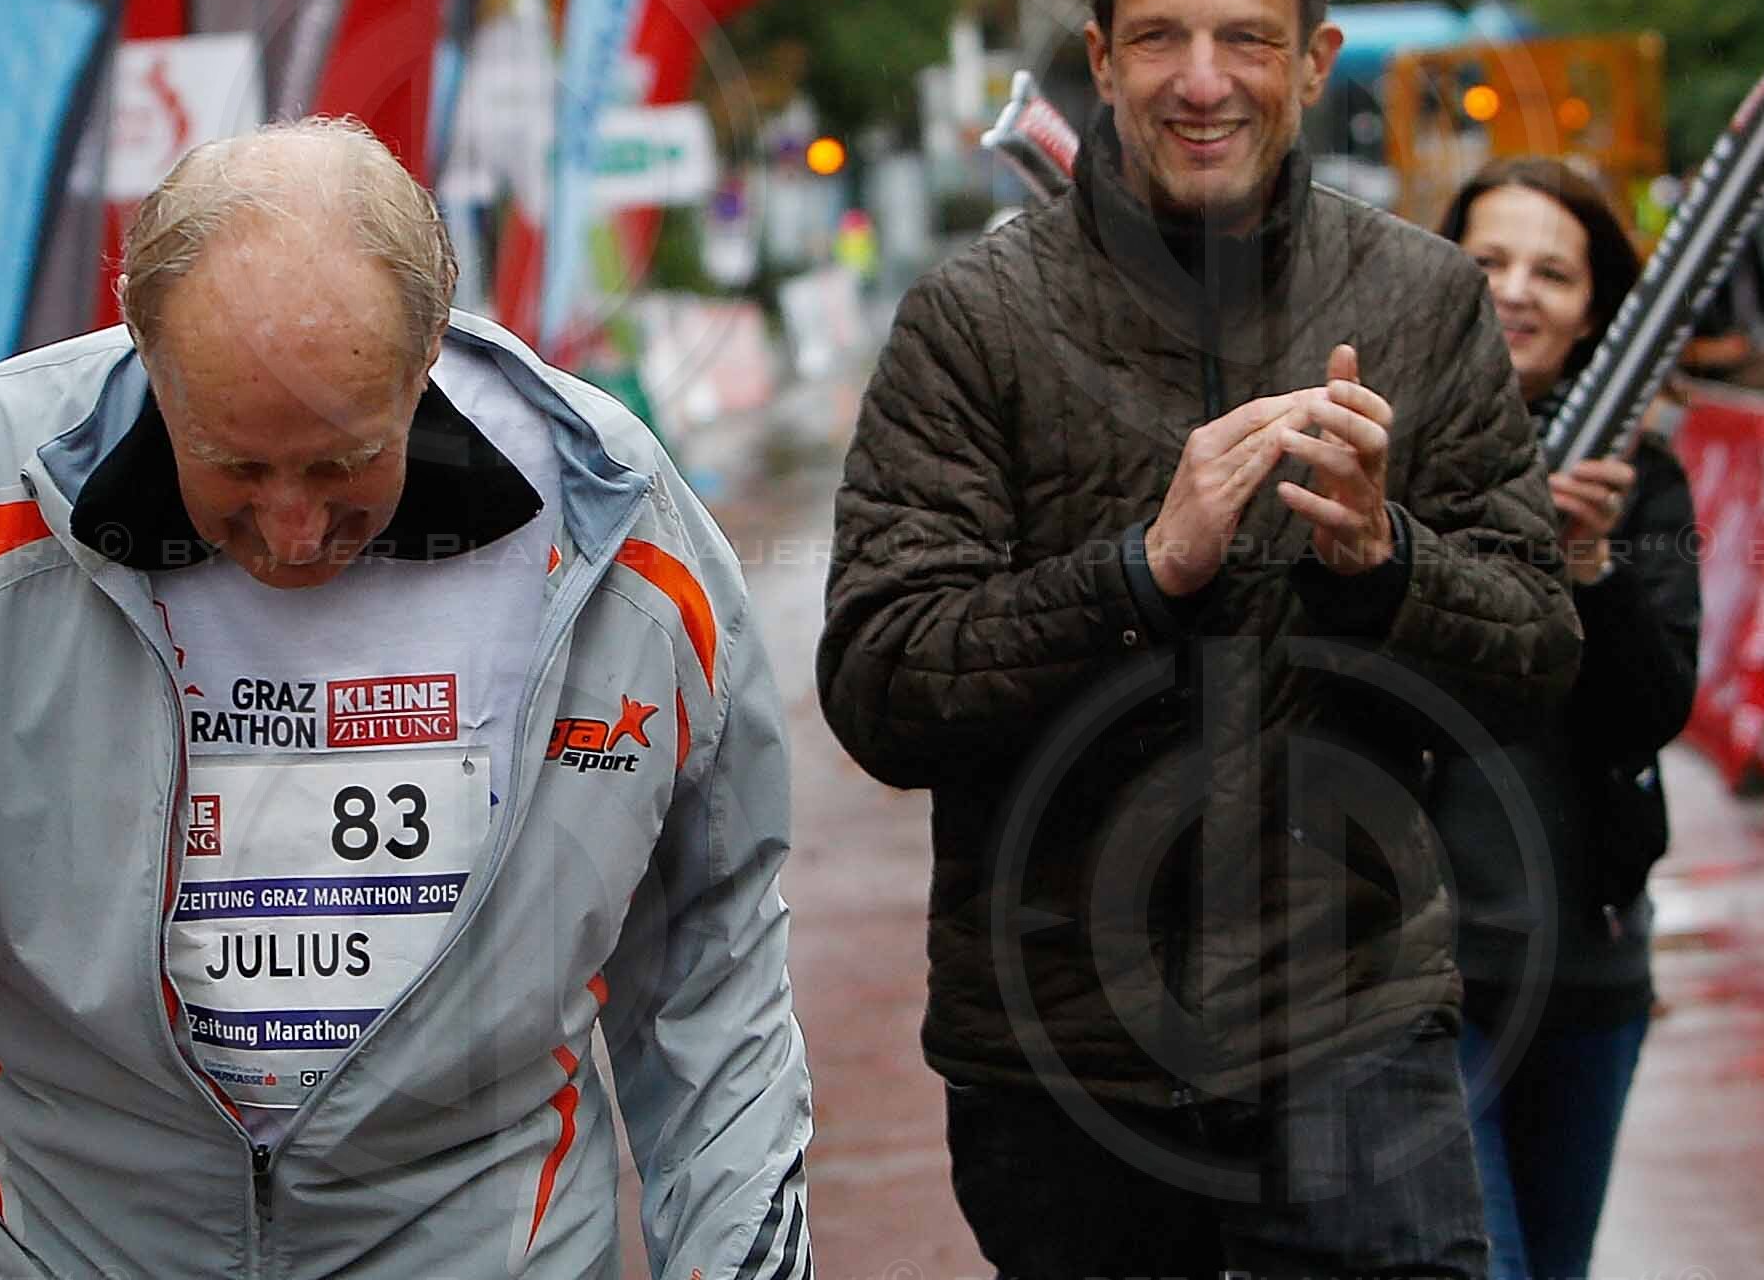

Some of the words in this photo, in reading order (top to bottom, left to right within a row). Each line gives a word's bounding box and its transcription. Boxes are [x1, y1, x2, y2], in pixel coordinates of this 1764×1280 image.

[232, 678, 316, 713] GRAZ
[334, 681, 451, 715] KLEINE
[191, 710, 316, 749] RATHON
[333, 715, 452, 742] ZEITUNG
[560, 751, 640, 773] sport
[331, 783, 430, 862] 83
[179, 887, 255, 911] ZEITUNG
[260, 887, 309, 909] GRAZ
[314, 886, 413, 908] MARATHON
[417, 884, 460, 905] 2015
[204, 932, 372, 981] JULIUS
[188, 1014, 258, 1046] Zeitung
[264, 1020, 361, 1041] Marathon
